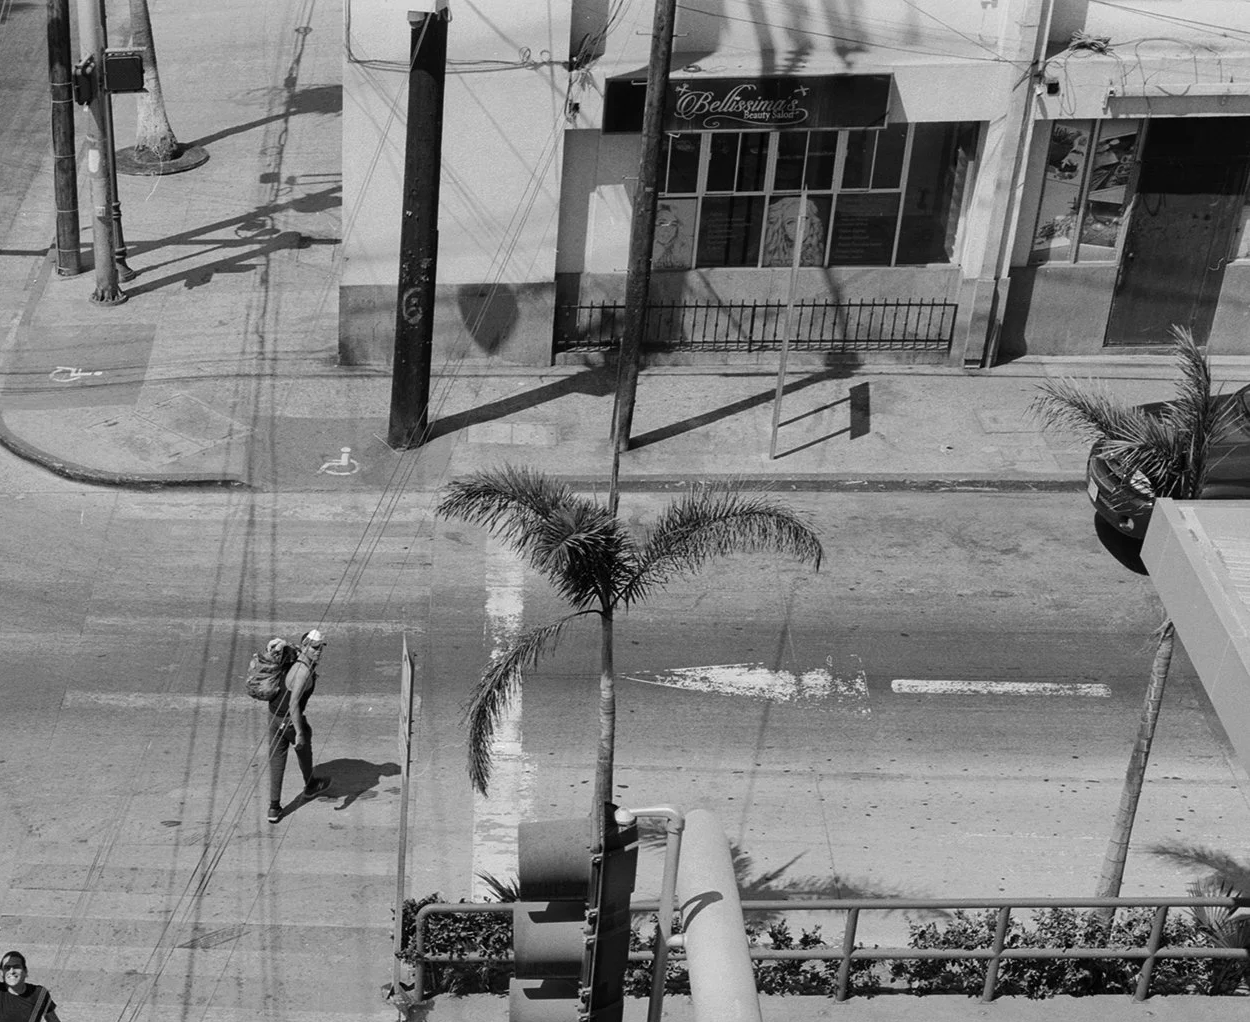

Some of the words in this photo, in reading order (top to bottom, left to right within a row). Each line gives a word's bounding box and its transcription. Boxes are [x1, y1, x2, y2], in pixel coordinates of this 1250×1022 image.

[674, 85, 799, 120] Bellissima's
[743, 111, 770, 121] Beauty
[771, 110, 794, 119] Salon
